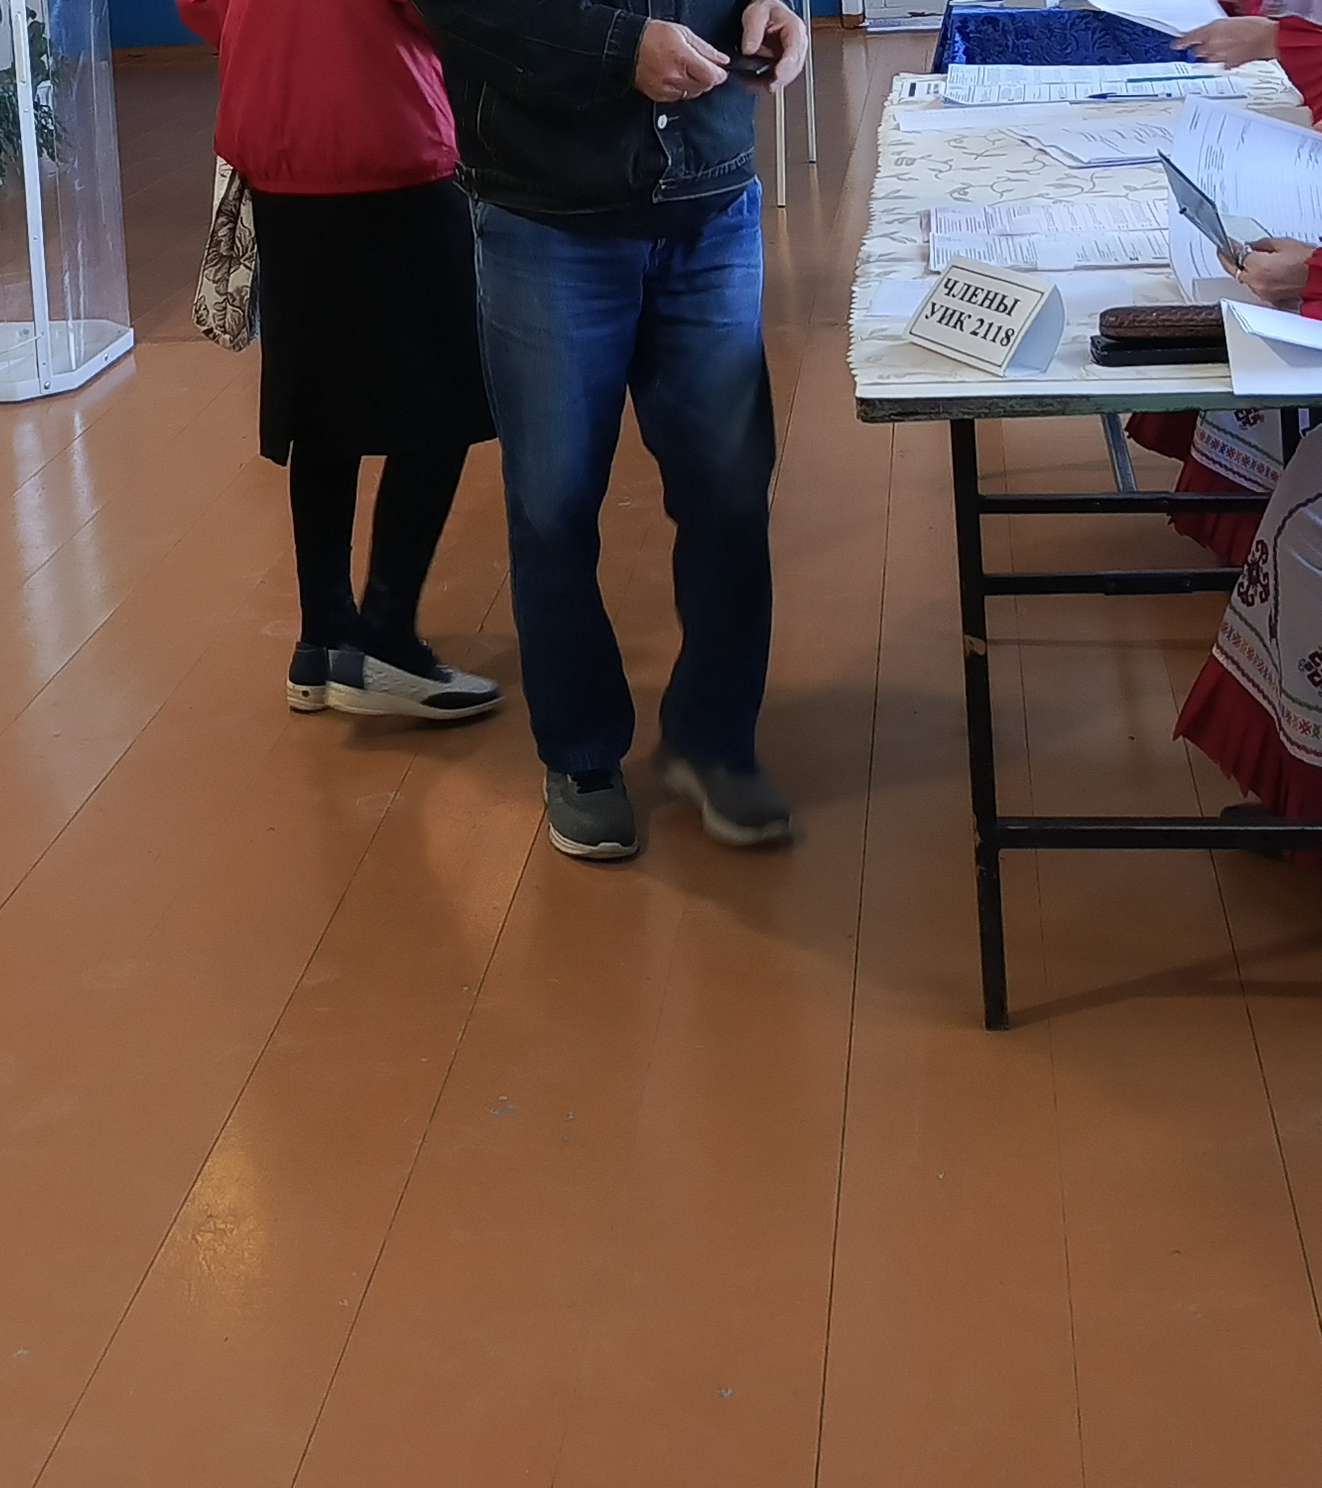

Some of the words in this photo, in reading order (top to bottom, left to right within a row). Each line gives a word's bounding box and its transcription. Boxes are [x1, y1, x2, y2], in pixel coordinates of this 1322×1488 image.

[943, 277, 1021, 317] ЧЛЕНЫ
[925, 301, 972, 332] УИК
[970, 318, 1016, 347] 2118
